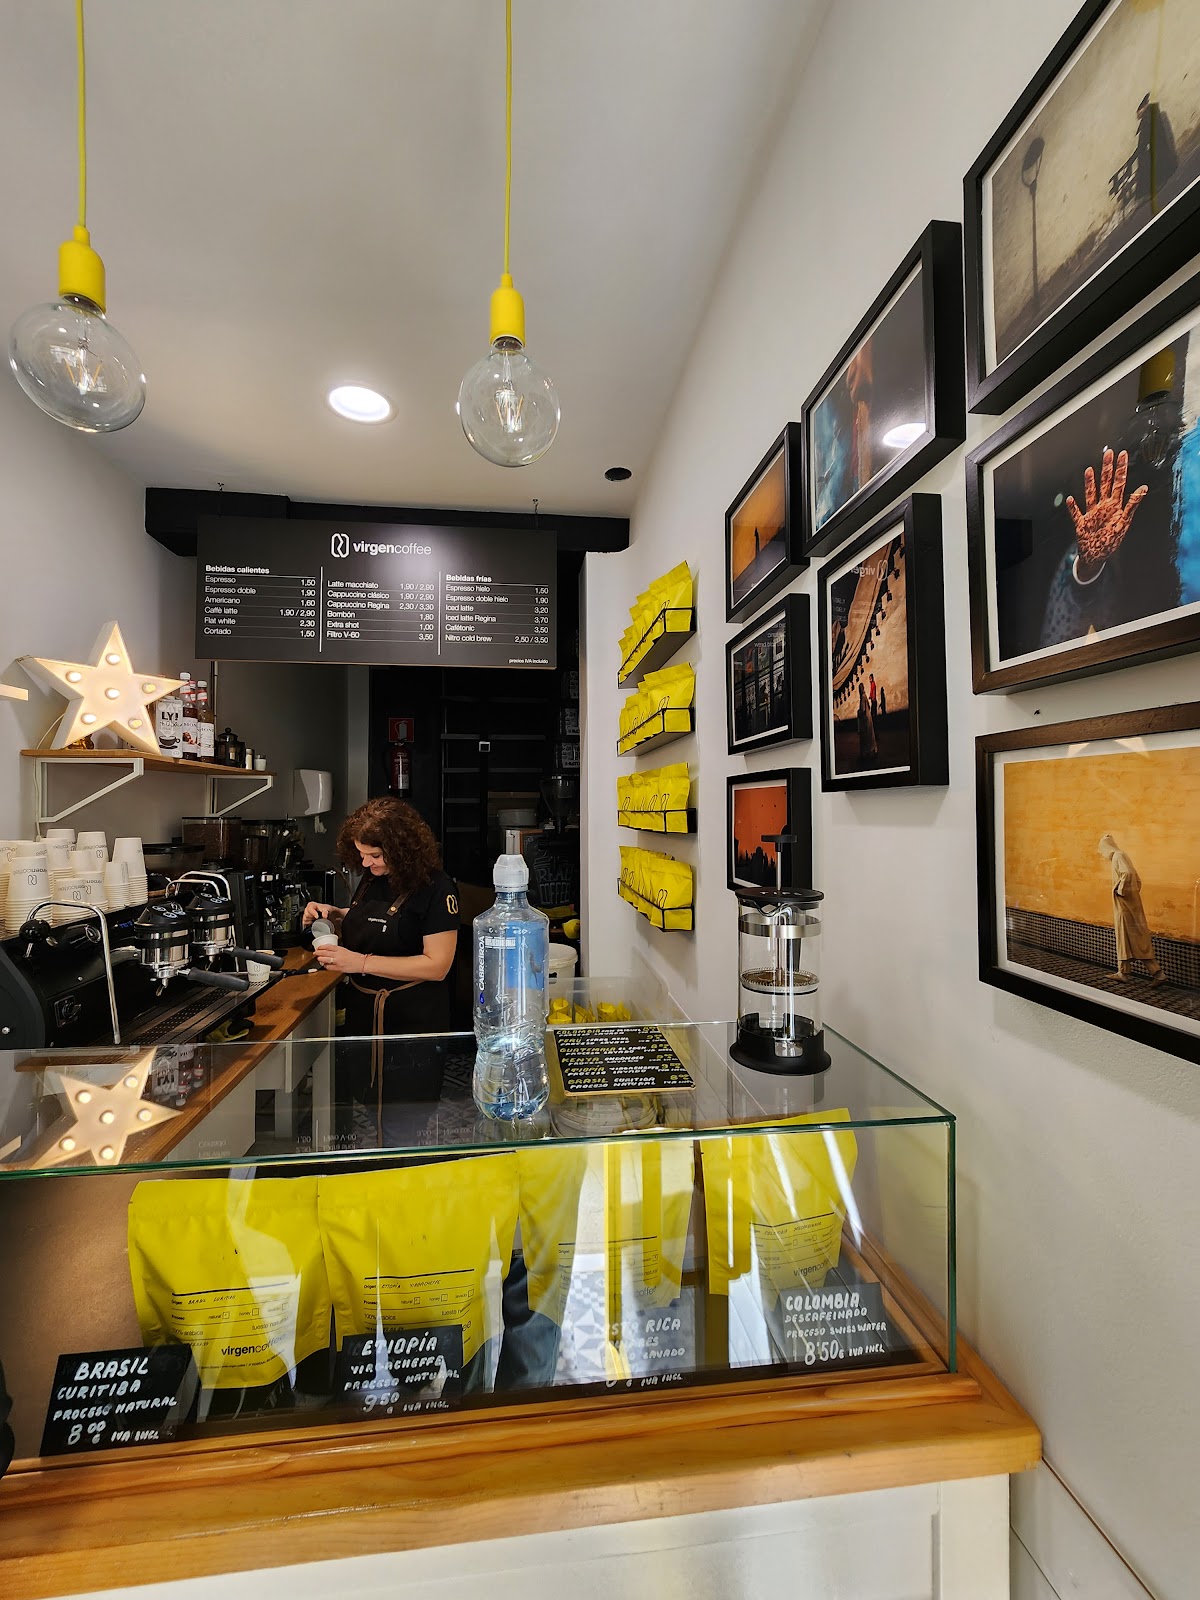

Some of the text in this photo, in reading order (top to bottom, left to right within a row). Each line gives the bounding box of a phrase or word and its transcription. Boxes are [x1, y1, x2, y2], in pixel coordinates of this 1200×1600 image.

[353, 541, 431, 555] virgencoffee
[237, 566, 269, 574] calientes
[205, 586, 236, 594] Espresso
[368, 602, 389, 610] Regina
[162, 712, 178, 720] LY!
[786, 1292, 860, 1312] COLOMBIA
[785, 1307, 867, 1323] DESCAFEINADO
[646, 1317, 681, 1332] RICA
[787, 1322, 886, 1338] PROCESO SWISS WATER
[222, 1334, 286, 1356] virgencoffee
[362, 1331, 438, 1356] ETIOPÍA
[849, 1347, 863, 1357] IVA
[865, 1344, 885, 1353] INCL
[643, 1348, 685, 1360] LAVADO
[74, 1357, 149, 1381] BRASIL
[344, 1378, 399, 1392] PROCESO
[641, 1377, 658, 1387] IVA
[662, 1373, 683, 1382] INCL
[57, 1379, 141, 1401] CURITIBA
[53, 1396, 178, 1421] PROCESO NATURAL
[403, 1401, 422, 1412] IVA
[111, 1430, 131, 1442] IVA
[135, 1430, 160, 1441] INCL
